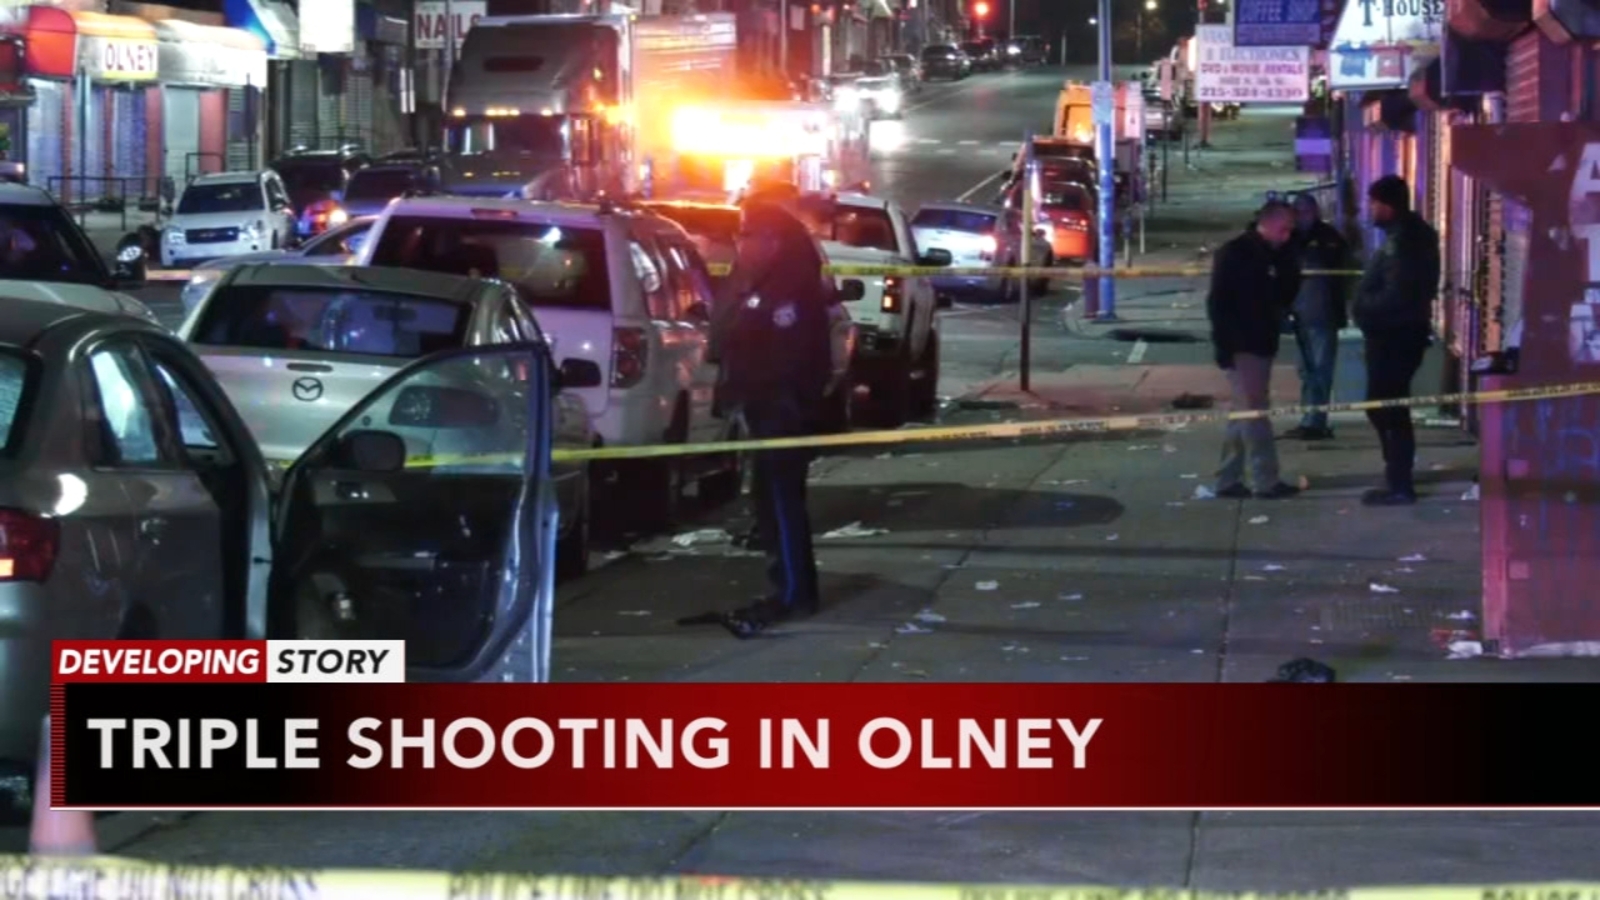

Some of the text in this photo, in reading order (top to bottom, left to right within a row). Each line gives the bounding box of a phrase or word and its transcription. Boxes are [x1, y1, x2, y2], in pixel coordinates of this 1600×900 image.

[105, 42, 156, 71] OLNEY
[1231, 64, 1260, 74] MOVIE
[1264, 64, 1304, 75] RENTALS
